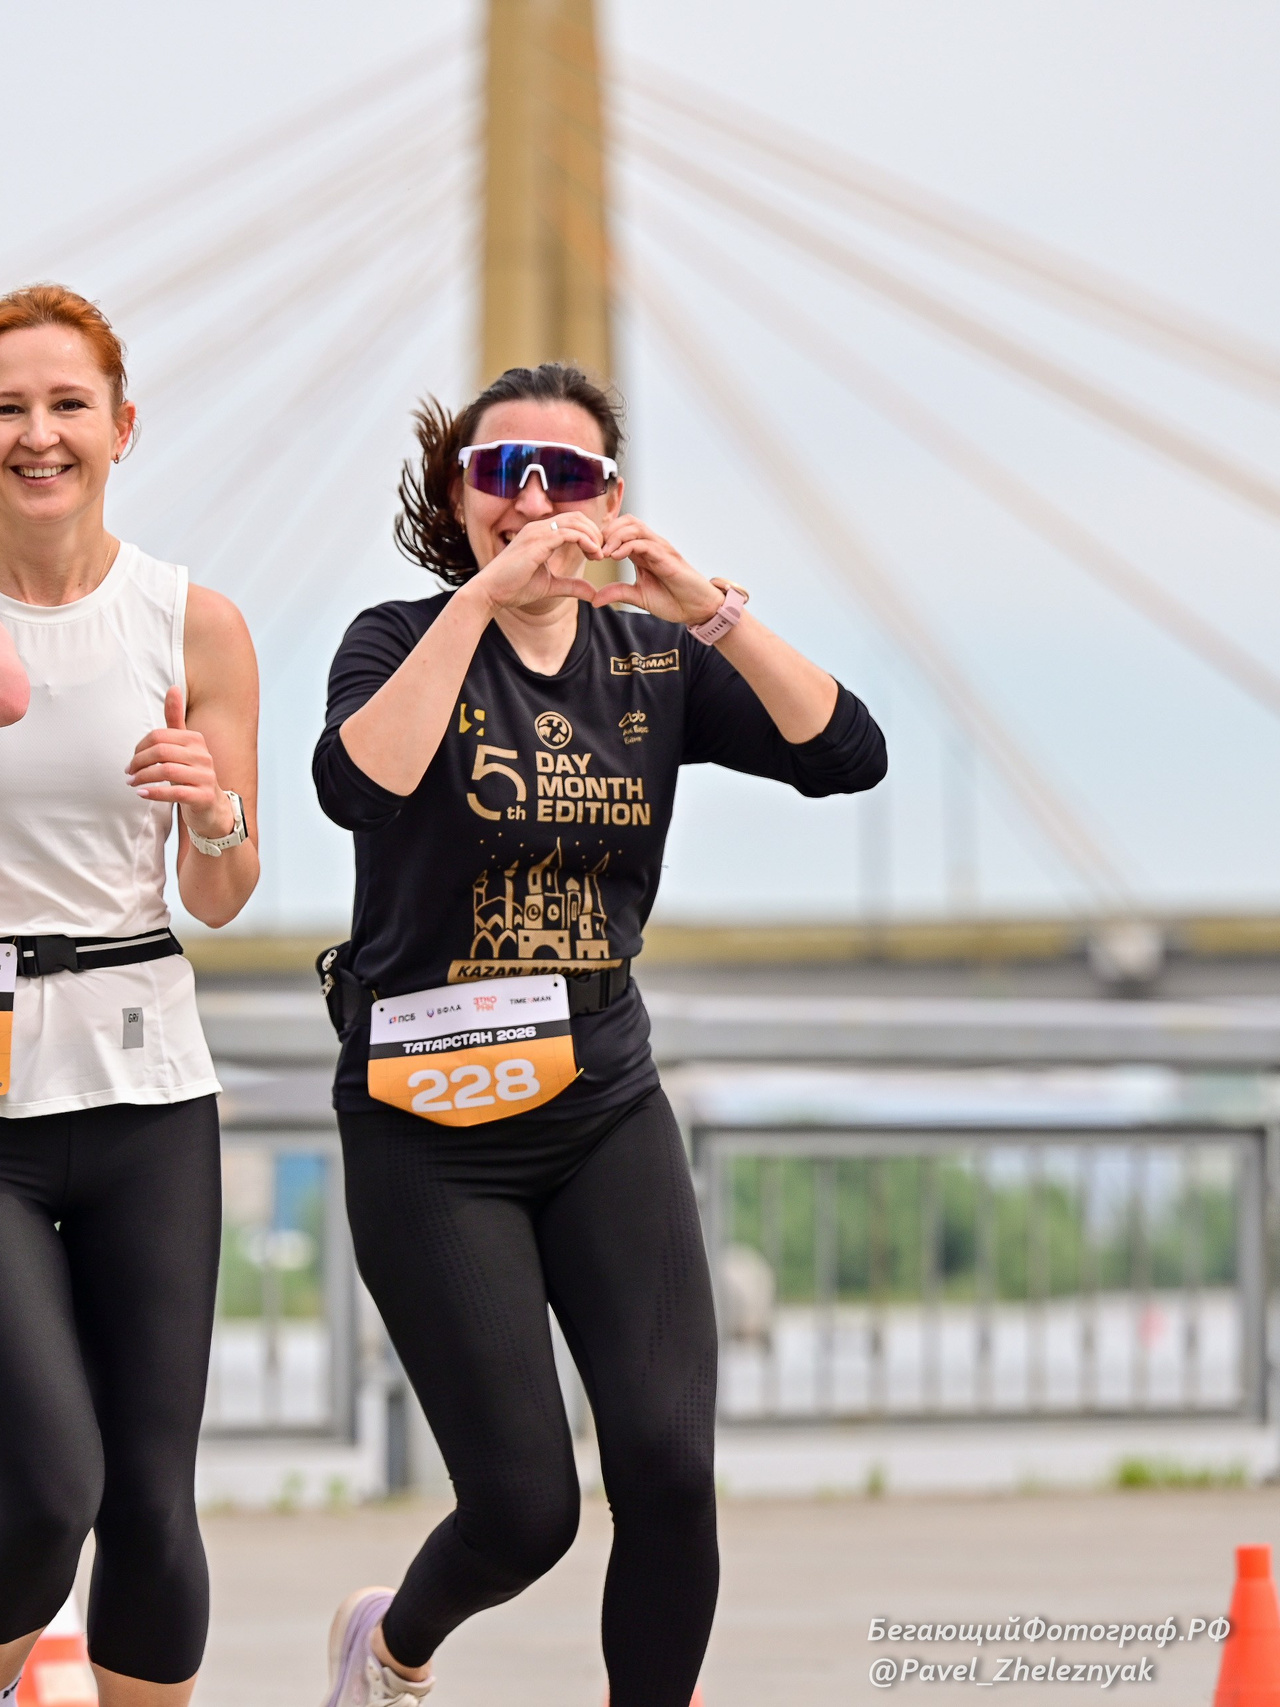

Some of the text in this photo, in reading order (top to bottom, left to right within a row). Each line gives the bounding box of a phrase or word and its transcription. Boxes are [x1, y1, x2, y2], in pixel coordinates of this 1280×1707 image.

[535, 751, 592, 775] DAY
[537, 775, 644, 800] MONTH
[536, 799, 651, 826] EDITION
[457, 966, 523, 978] KAZAN
[398, 1013, 416, 1023] ПСБ
[402, 1026, 537, 1054] ТАТАРСТАН 2026
[407, 1058, 541, 1113] 228
